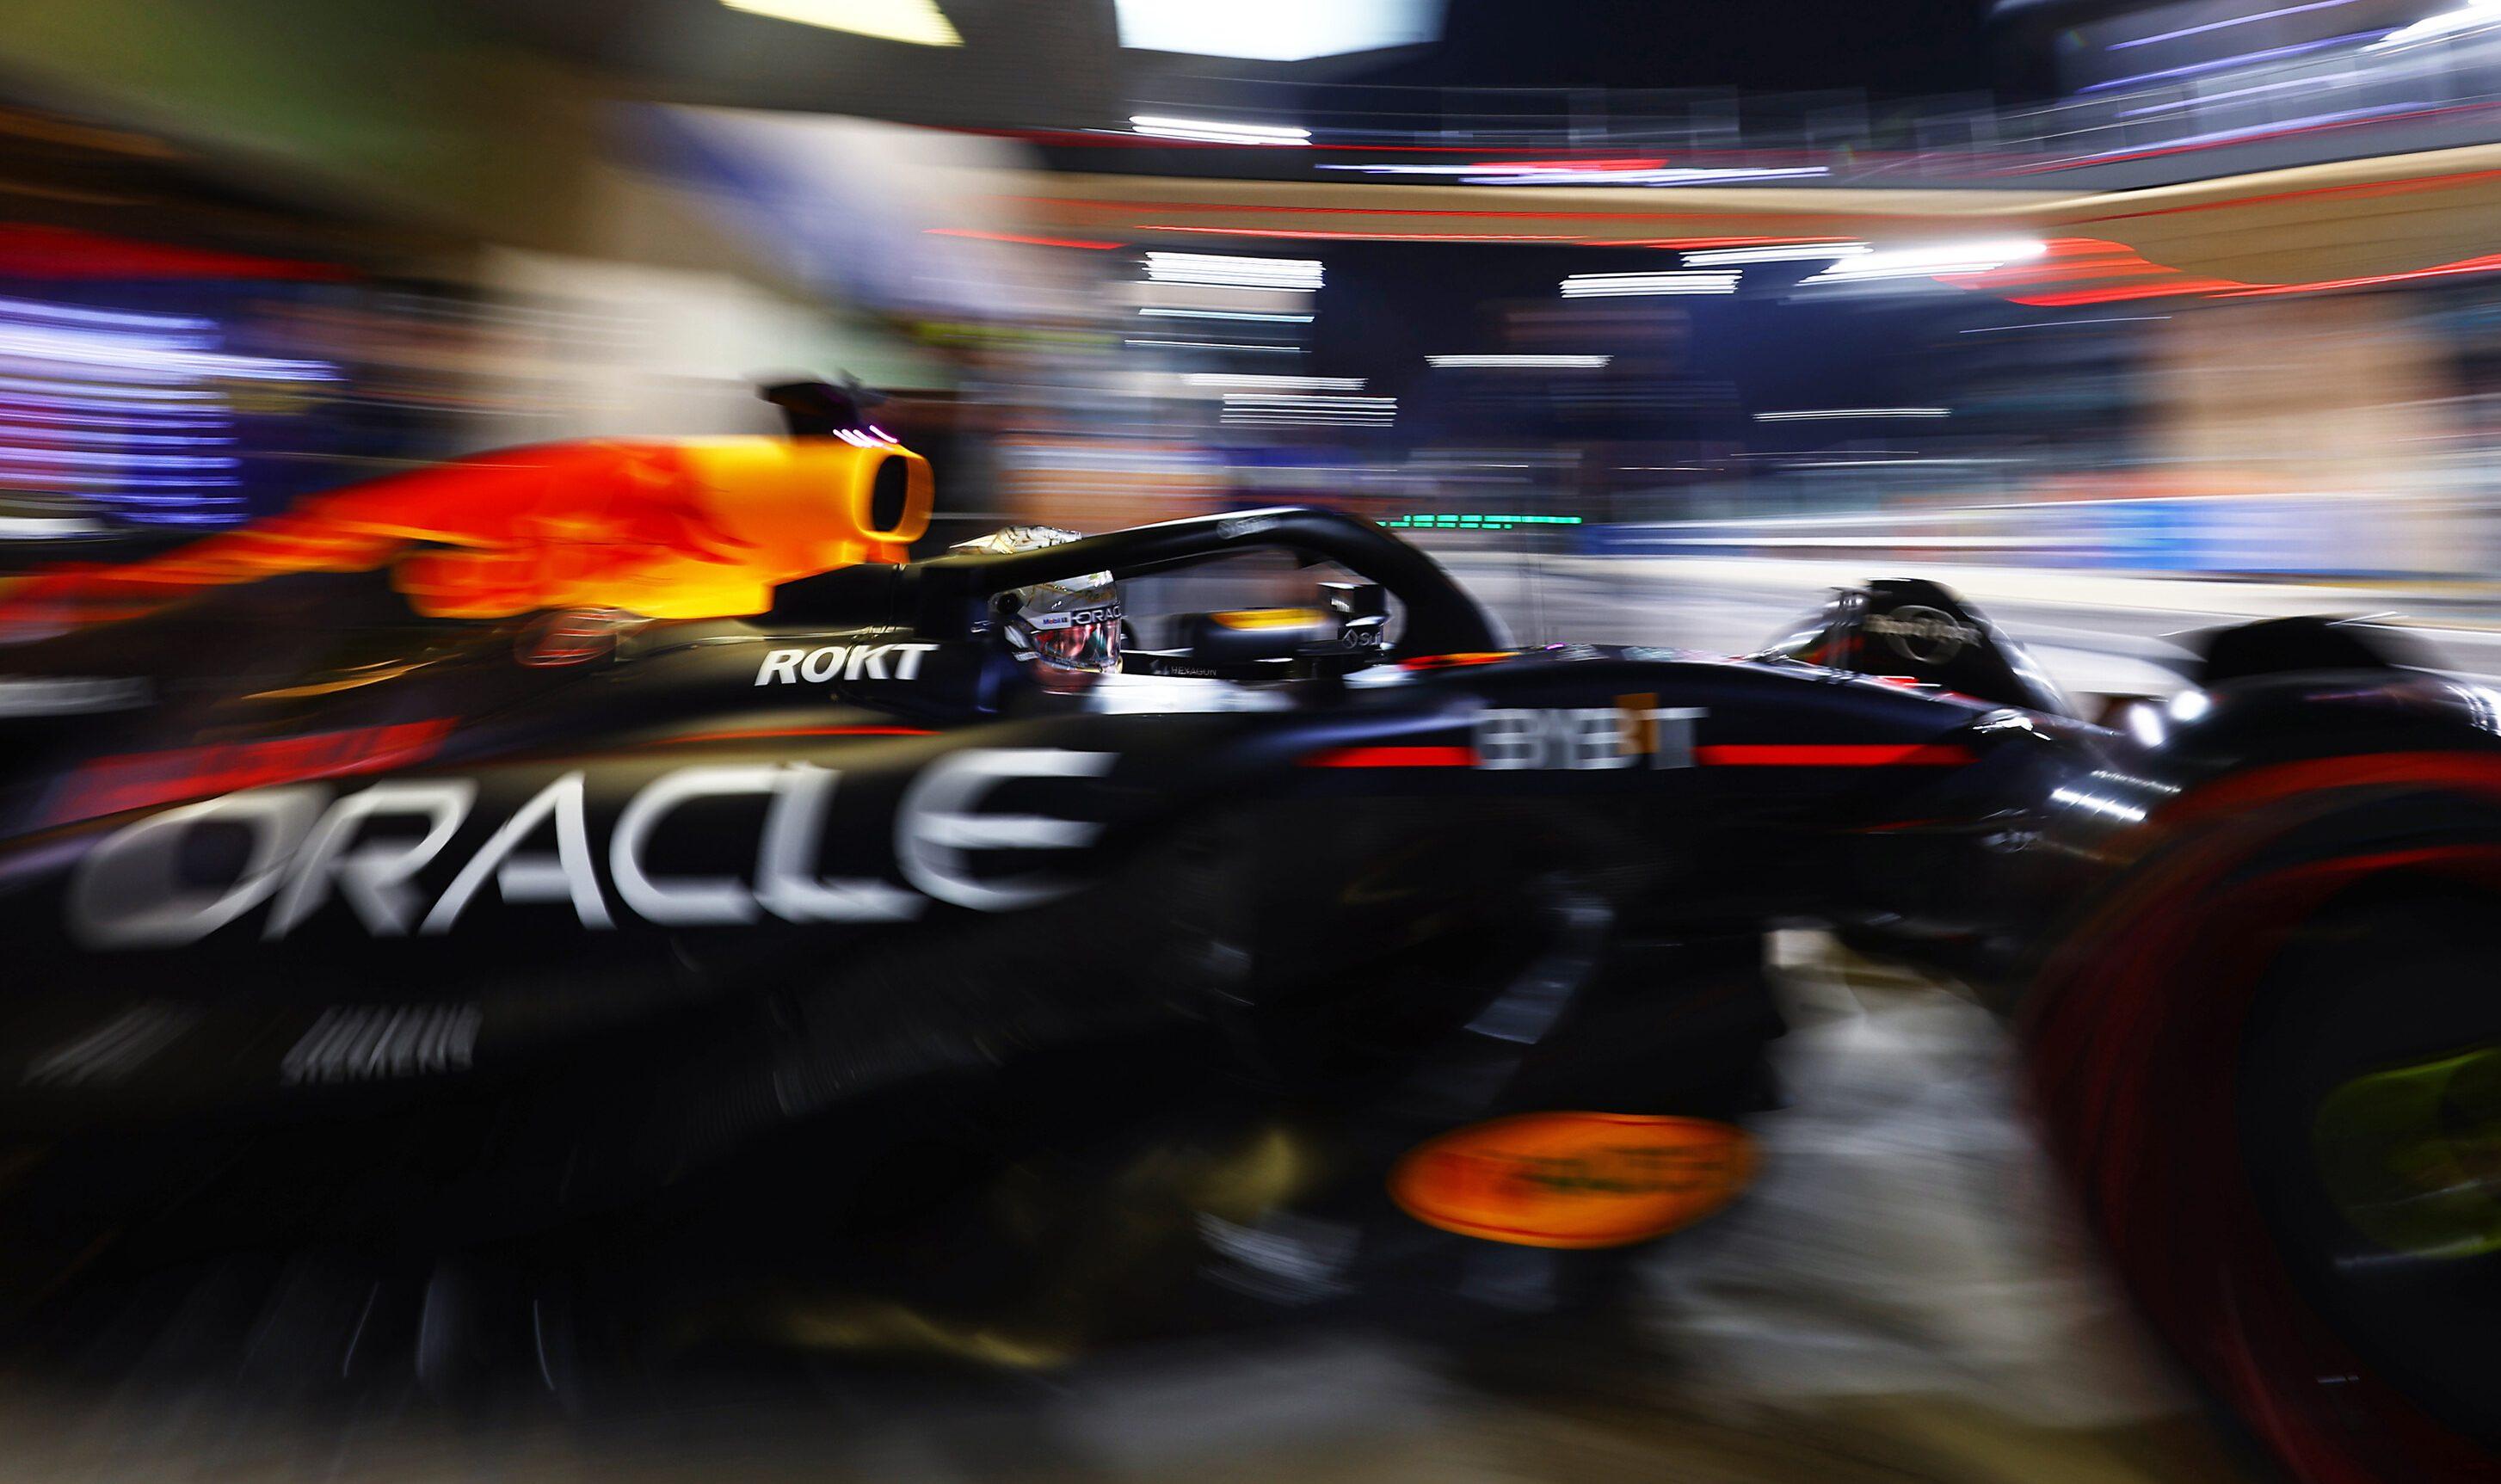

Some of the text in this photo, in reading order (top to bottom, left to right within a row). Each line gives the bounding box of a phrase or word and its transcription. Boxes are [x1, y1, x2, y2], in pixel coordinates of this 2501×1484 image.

[755, 643, 940, 687] ROKT
[1171, 665, 1217, 676] HEXAGON
[69, 745, 1118, 950] ORACLE
